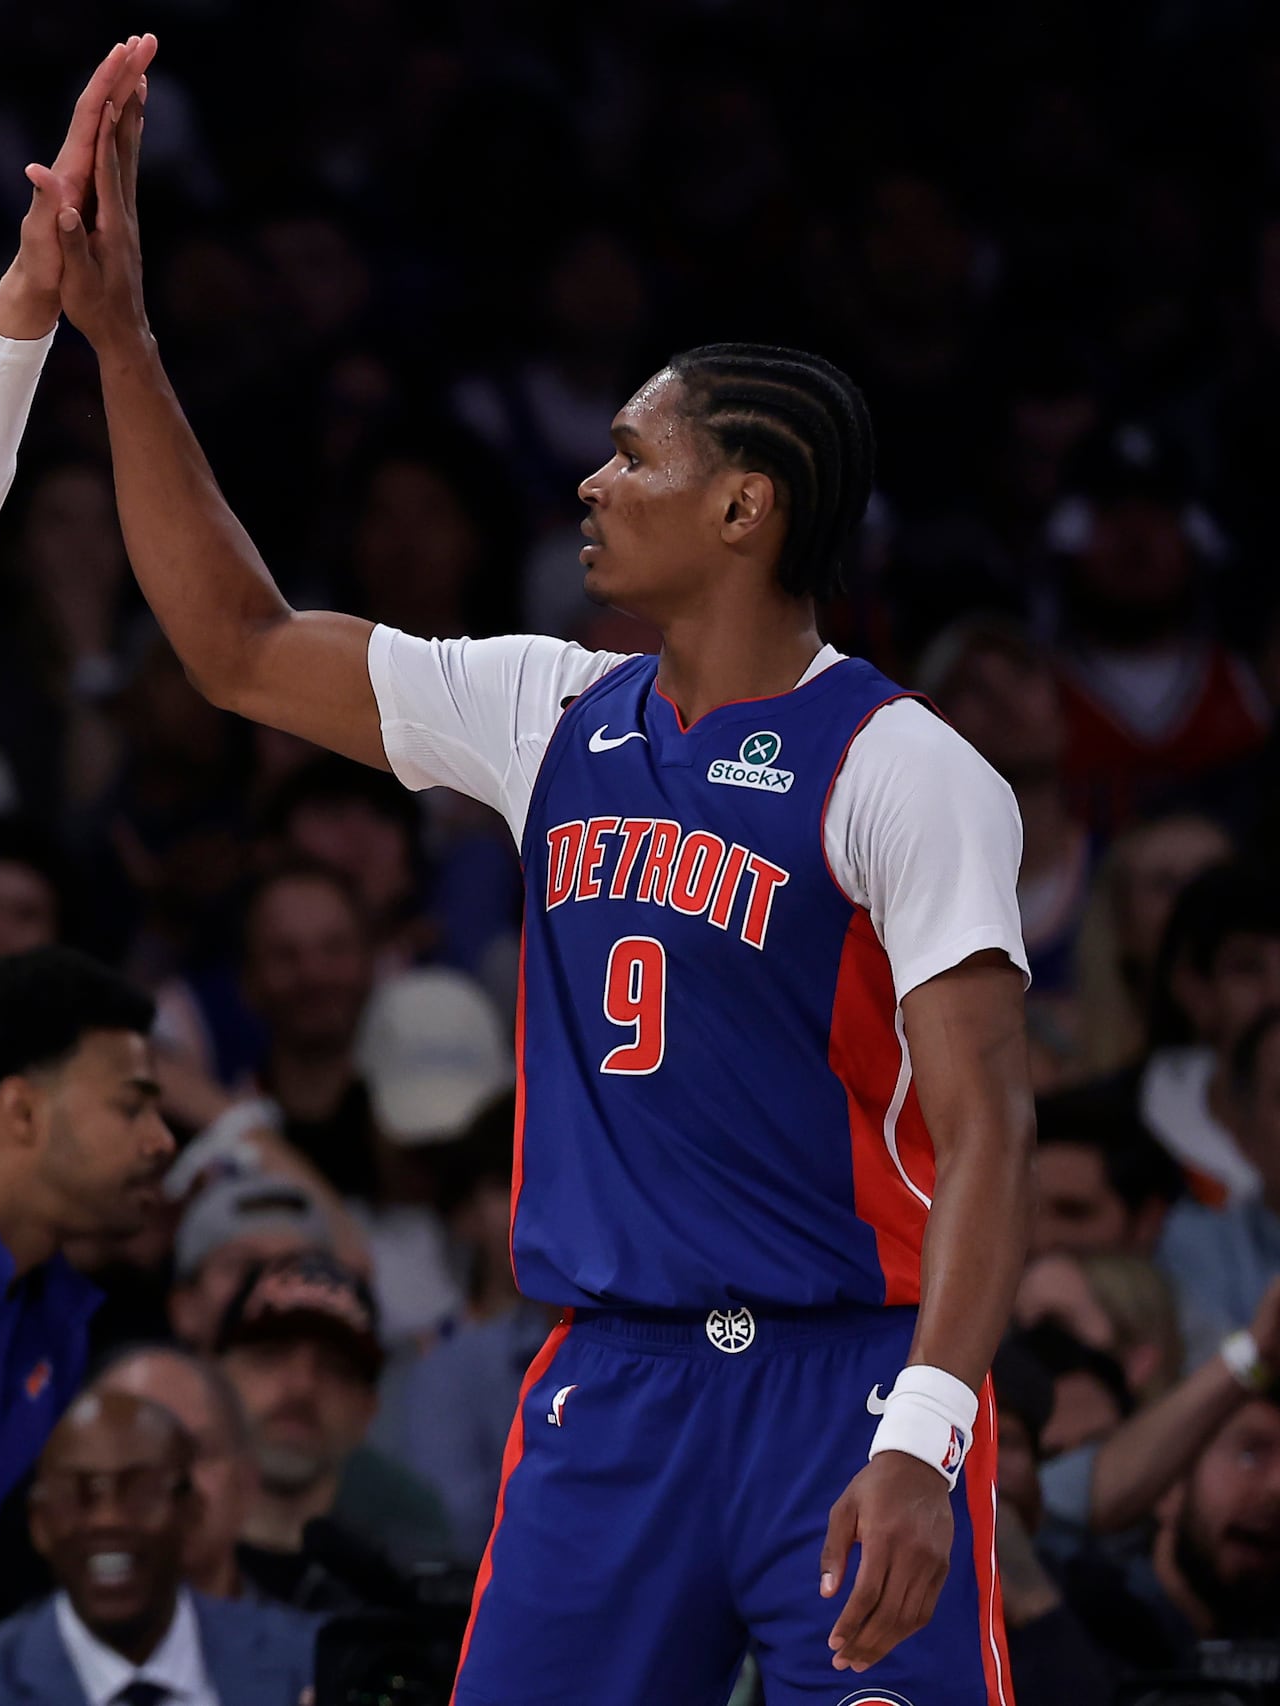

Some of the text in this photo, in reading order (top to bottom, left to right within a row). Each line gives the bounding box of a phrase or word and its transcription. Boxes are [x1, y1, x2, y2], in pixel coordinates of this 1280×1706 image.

[711, 762, 792, 790] StockX
[546, 816, 790, 951] DETROIT
[599, 935, 667, 1076] 9
